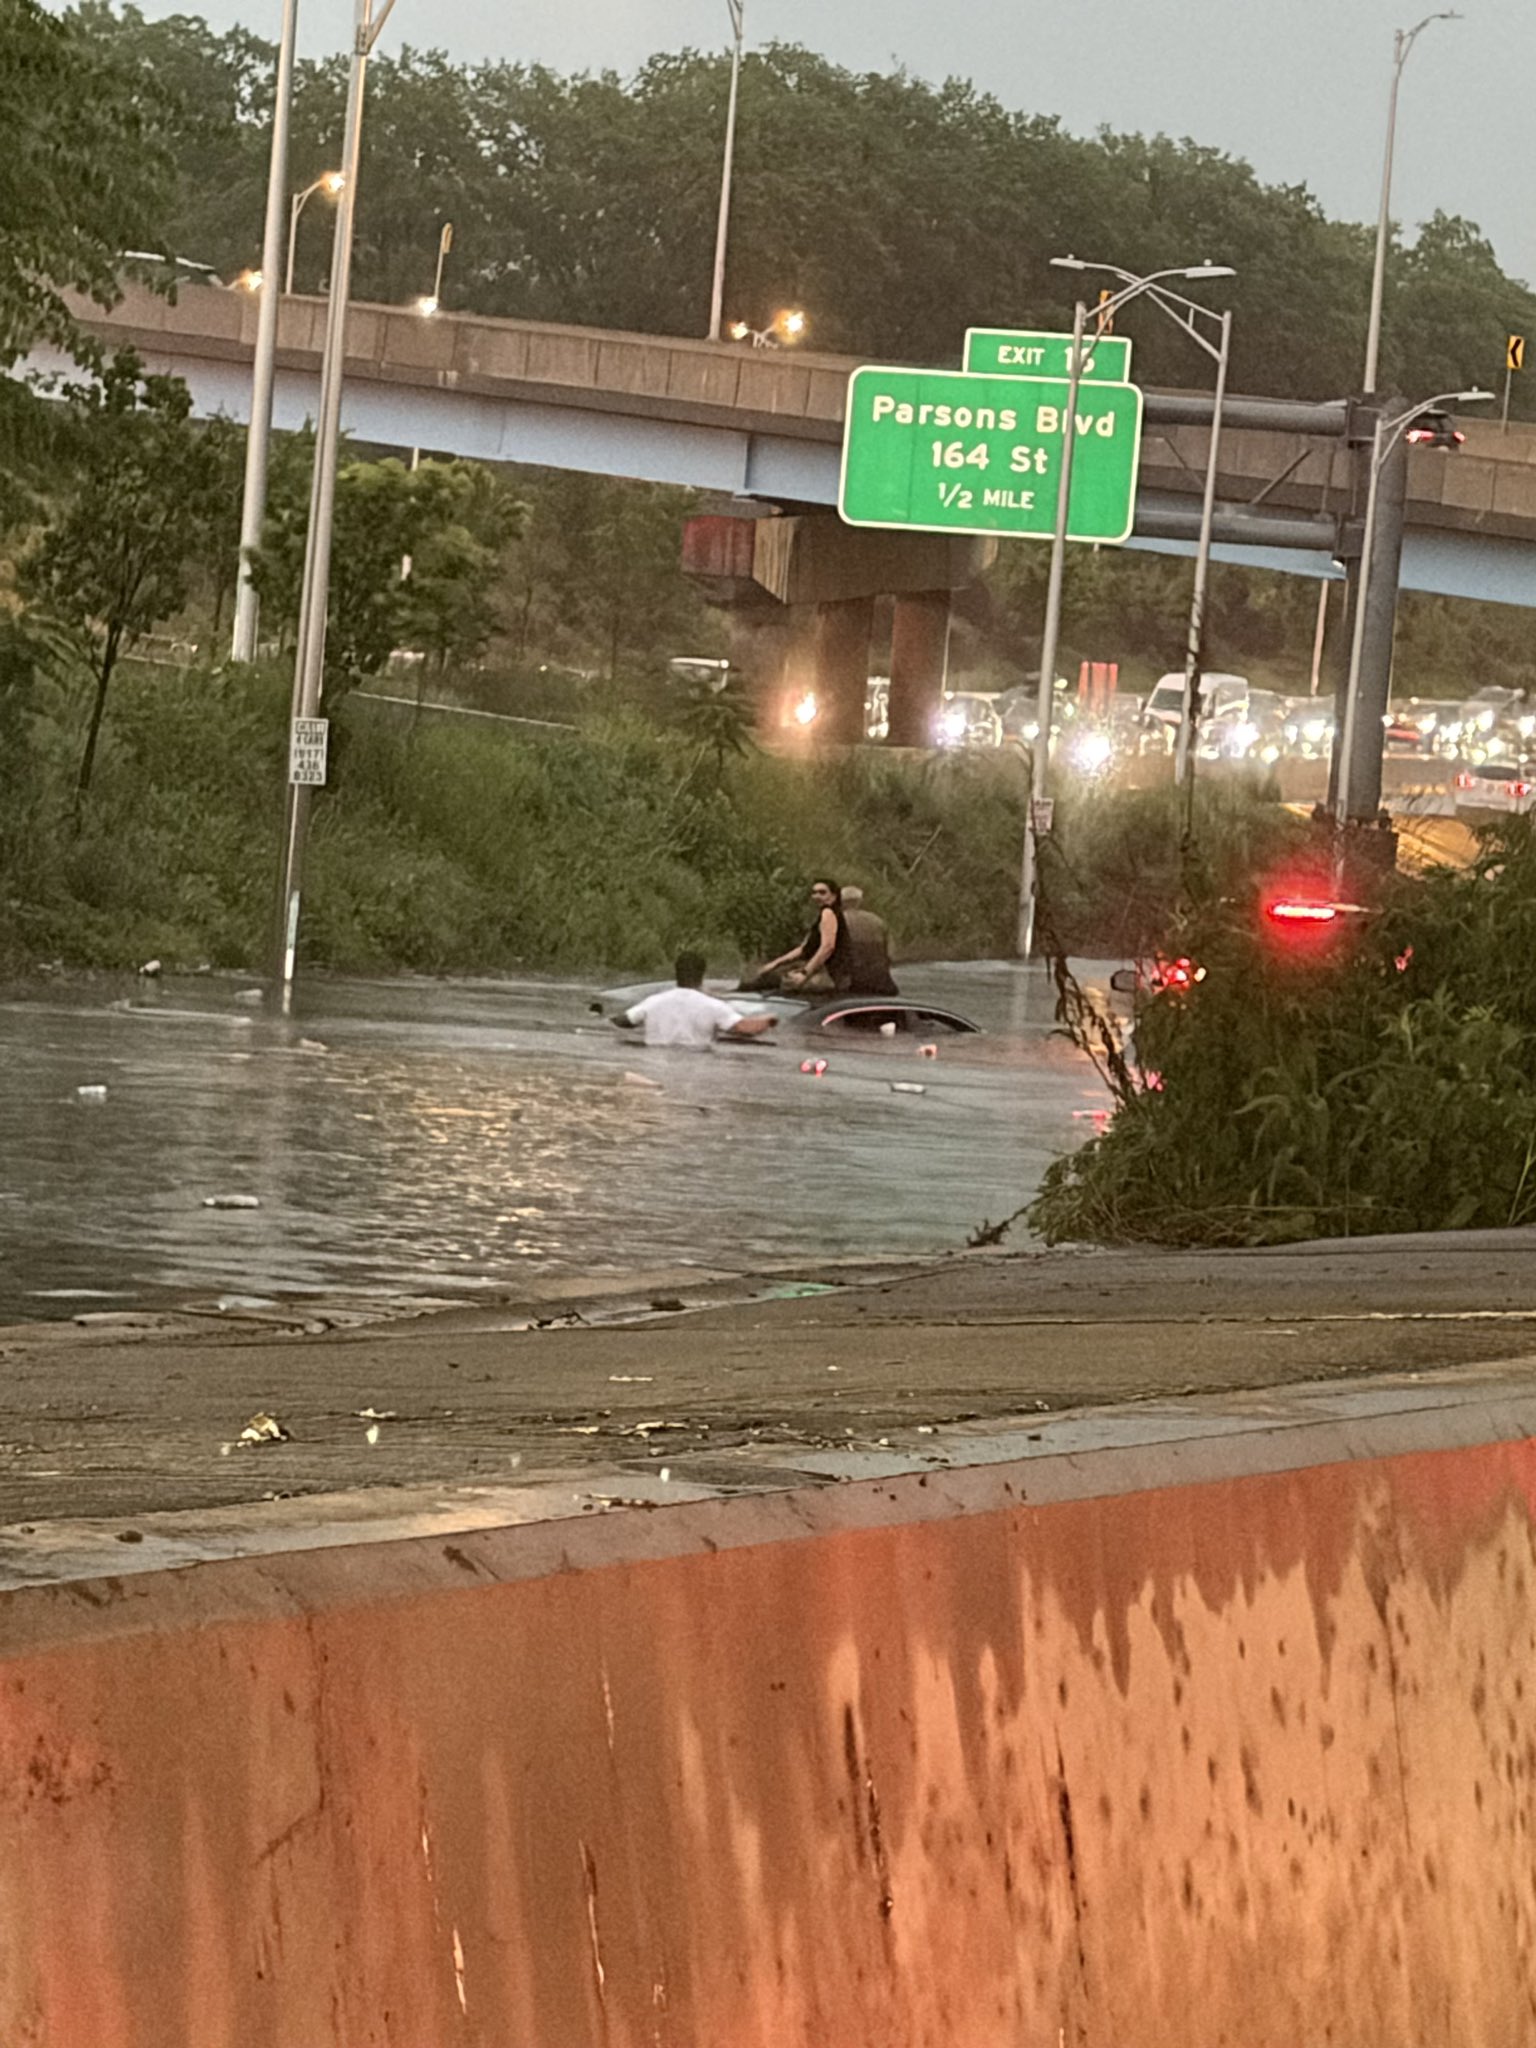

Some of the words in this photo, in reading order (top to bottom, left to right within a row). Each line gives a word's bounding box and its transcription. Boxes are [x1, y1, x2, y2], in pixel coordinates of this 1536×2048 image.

[997, 344, 1046, 366] EXIT
[872, 395, 1017, 431] Parsons
[1036, 405, 1115, 437] Blvd
[932, 440, 990, 470] 164
[1009, 445, 1049, 474] St
[938, 482, 973, 509] 1/2
[983, 488, 1035, 509] MILE
